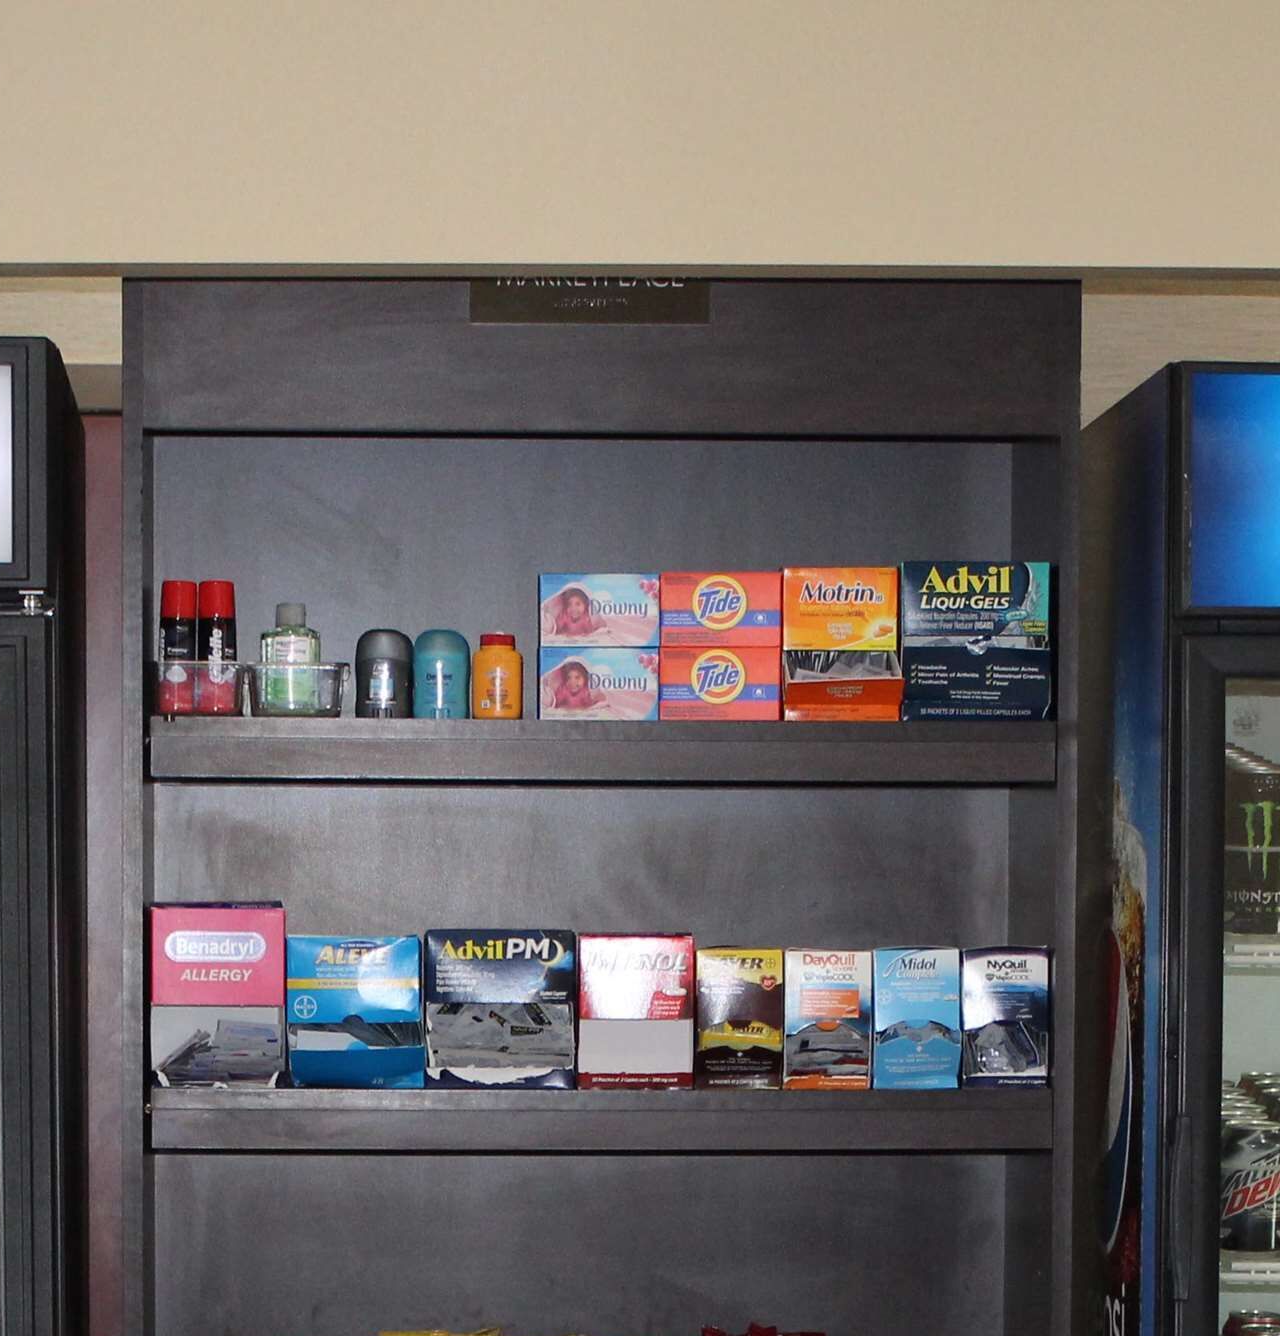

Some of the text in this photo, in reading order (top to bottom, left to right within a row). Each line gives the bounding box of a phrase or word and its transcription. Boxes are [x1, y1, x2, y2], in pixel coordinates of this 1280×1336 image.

[919, 565, 1011, 593] Advil
[800, 582, 875, 602] Motrin
[590, 599, 648, 617] Downy
[699, 588, 741, 620] Tide
[589, 673, 647, 691] Downy
[697, 662, 739, 694] Tide
[176, 936, 255, 960] Benadryl
[439, 938, 550, 960] Advil PM
[803, 954, 855, 967] DayQuil
[899, 958, 936, 970] Midol
[987, 960, 1026, 971] NyQuil
[180, 969, 253, 981] ALLERGY
